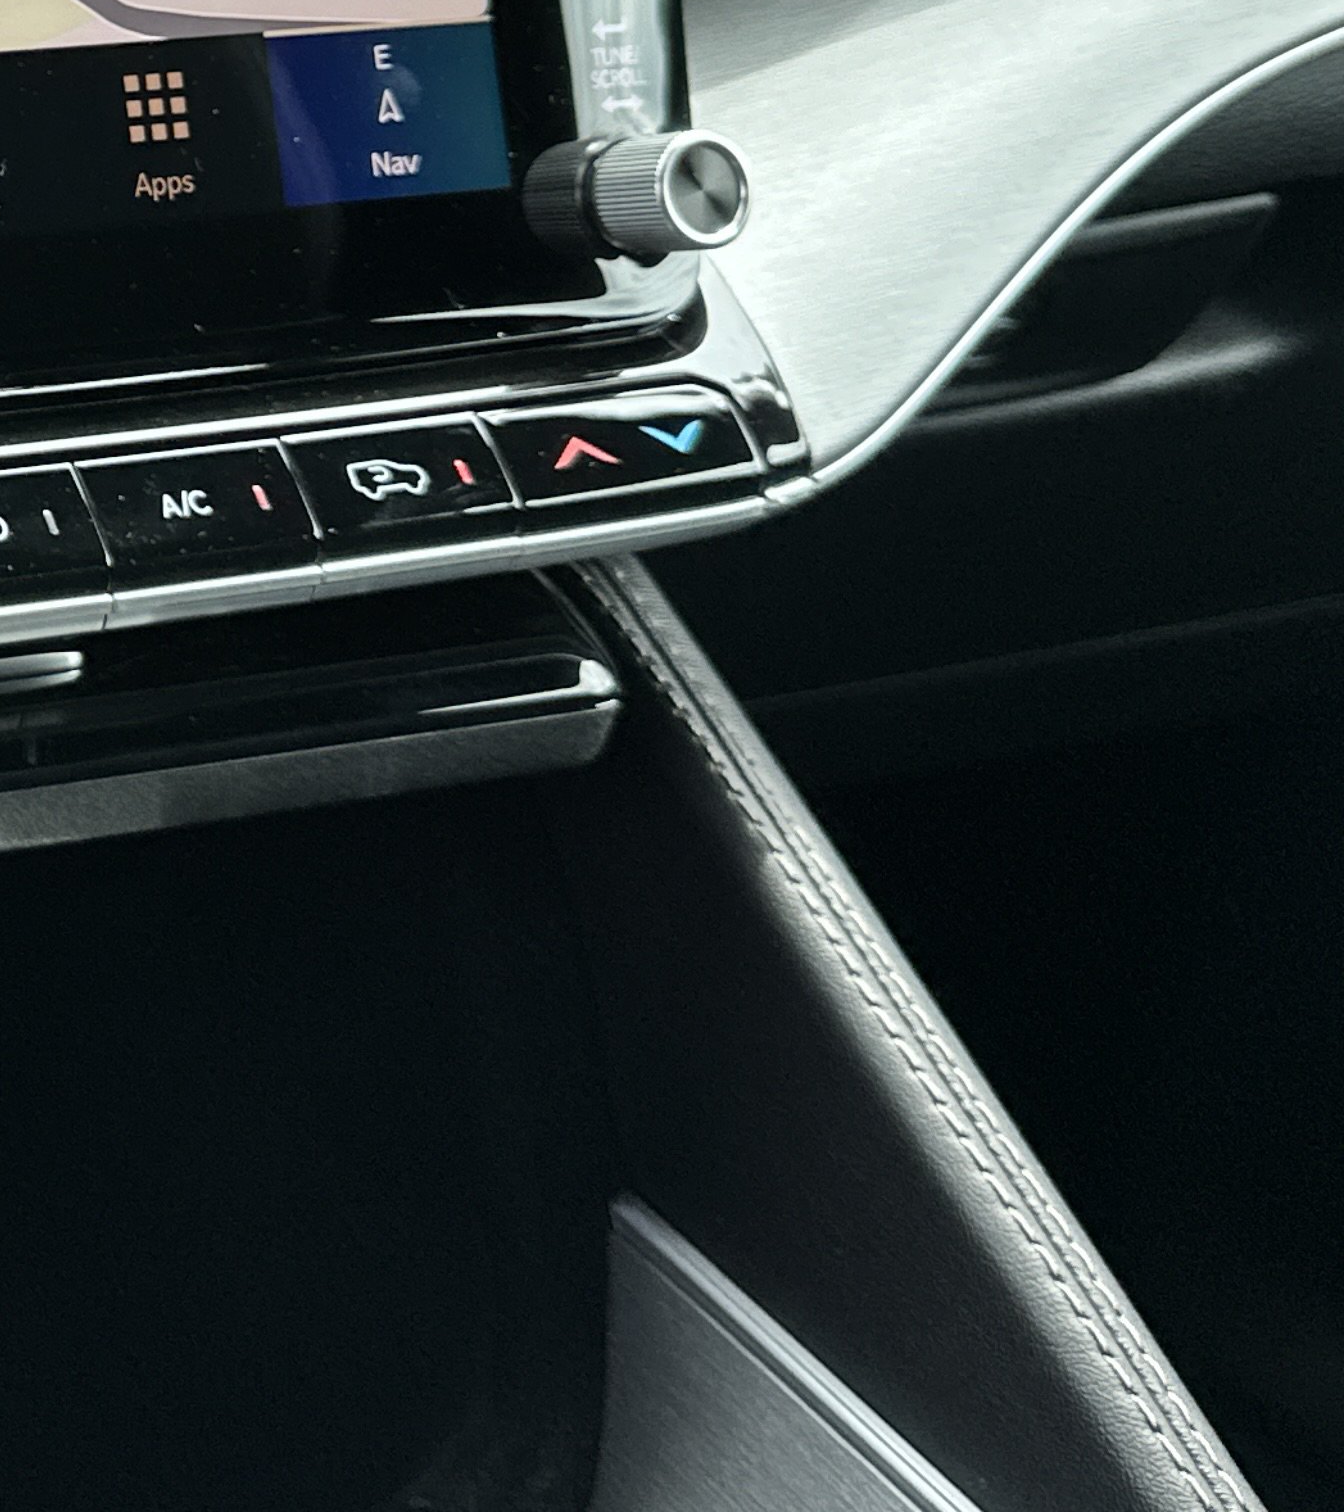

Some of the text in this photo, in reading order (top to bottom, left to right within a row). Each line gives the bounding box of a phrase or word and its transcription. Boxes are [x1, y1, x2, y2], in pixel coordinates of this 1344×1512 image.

[373, 44, 392, 71] E
[370, 152, 421, 178] Nav
[135, 170, 196, 202] Apps
[162, 490, 212, 520] A/C
